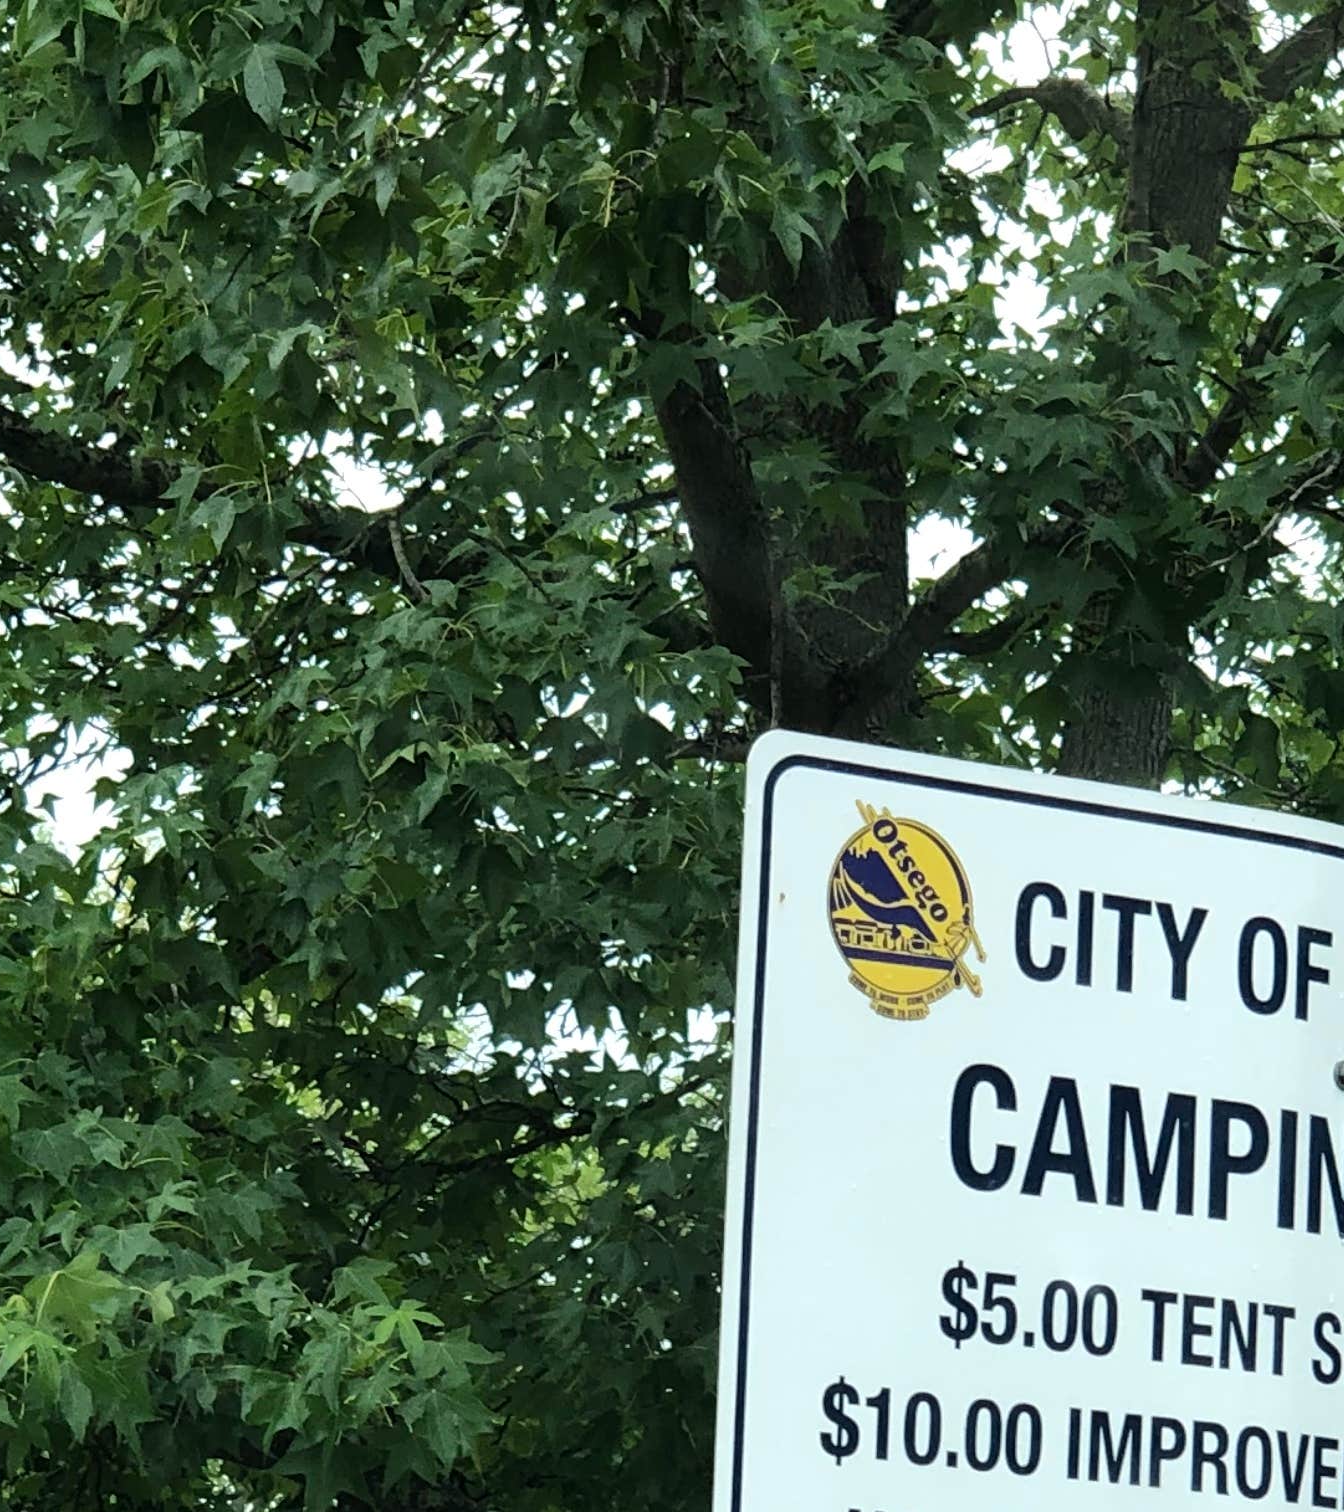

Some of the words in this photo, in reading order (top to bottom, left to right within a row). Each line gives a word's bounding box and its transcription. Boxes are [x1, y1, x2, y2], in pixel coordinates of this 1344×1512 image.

[872, 818, 949, 923] Otsego
[1015, 881, 1209, 1001] CITY
[1237, 916, 1333, 1021] OF
[939, 1260, 1118, 1356] $5.00
[1141, 1289, 1296, 1376] TENT
[820, 1375, 1043, 1476] $10.00
